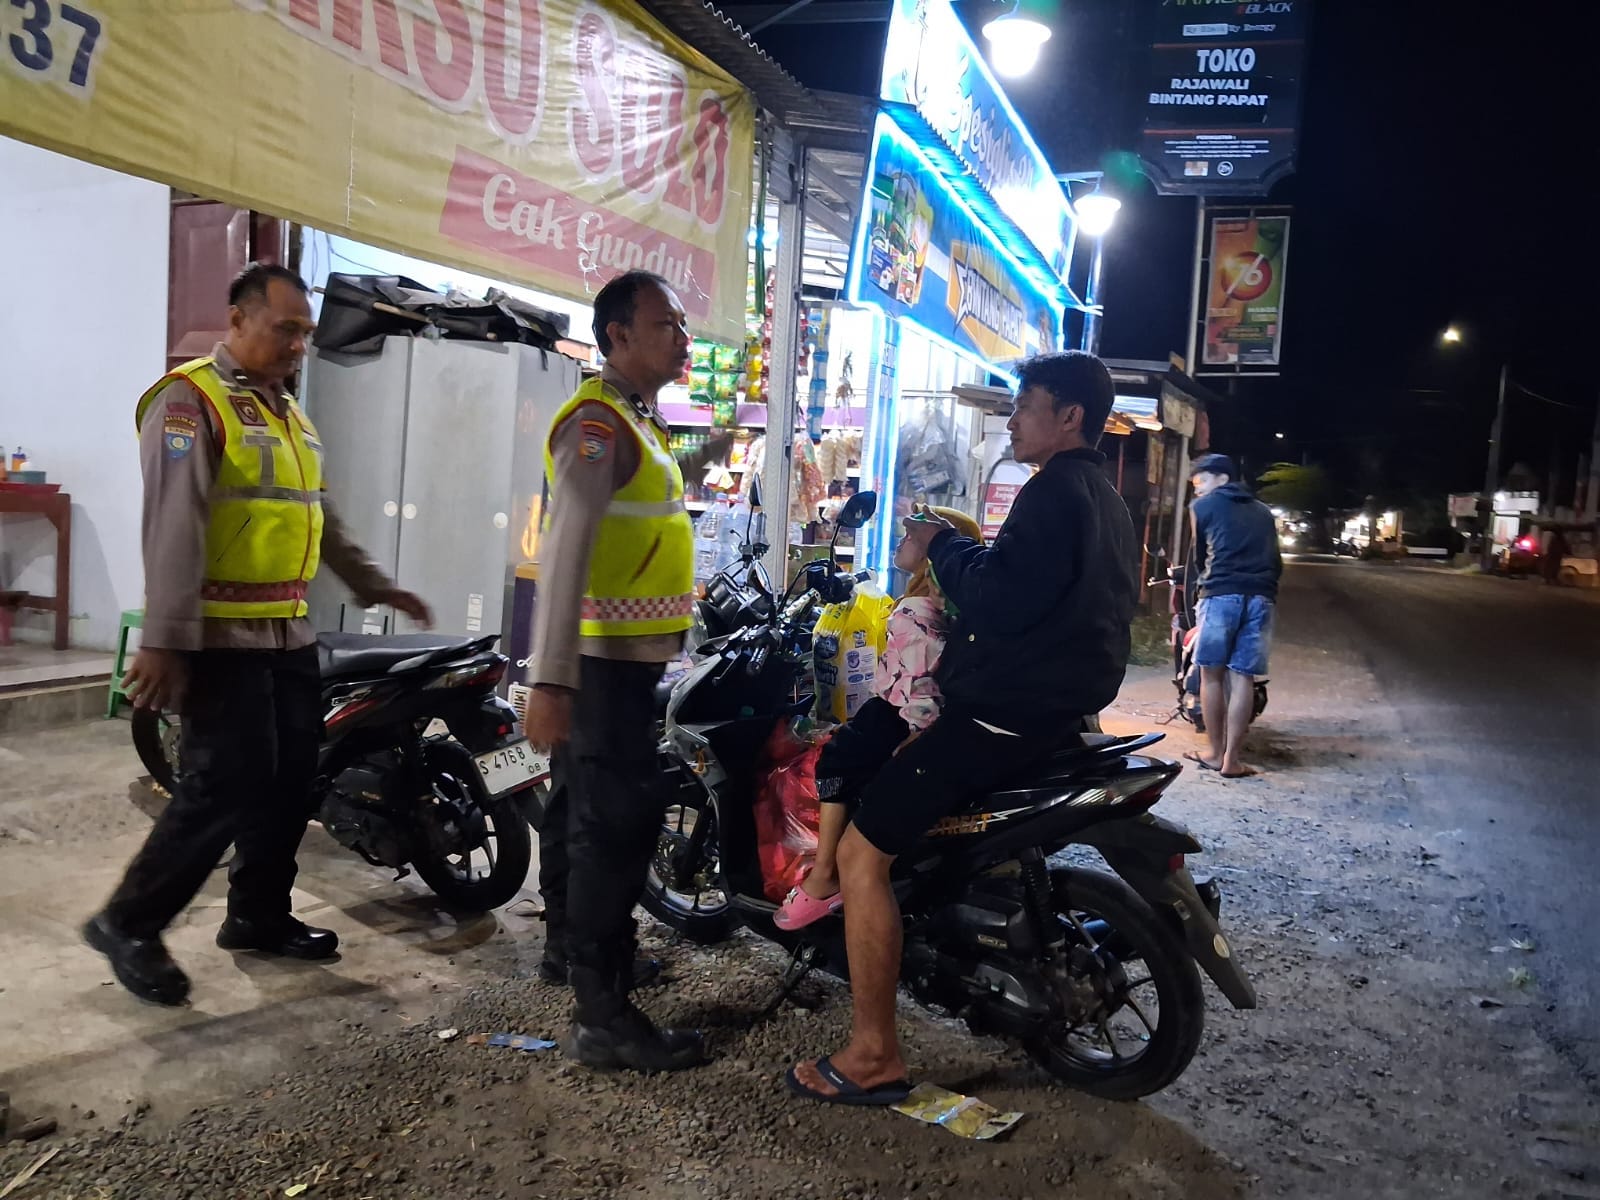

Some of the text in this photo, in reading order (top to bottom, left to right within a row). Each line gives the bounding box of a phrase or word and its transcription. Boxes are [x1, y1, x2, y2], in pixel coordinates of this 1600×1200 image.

[1197, 48, 1256, 72] TOKO
[1171, 79, 1250, 90] RAJAWALI
[1149, 93, 1269, 106] BINTANG PAPAT
[482, 174, 694, 293] Cak Gundul
[479, 760, 489, 775] S
[494, 746, 526, 769] 4768
